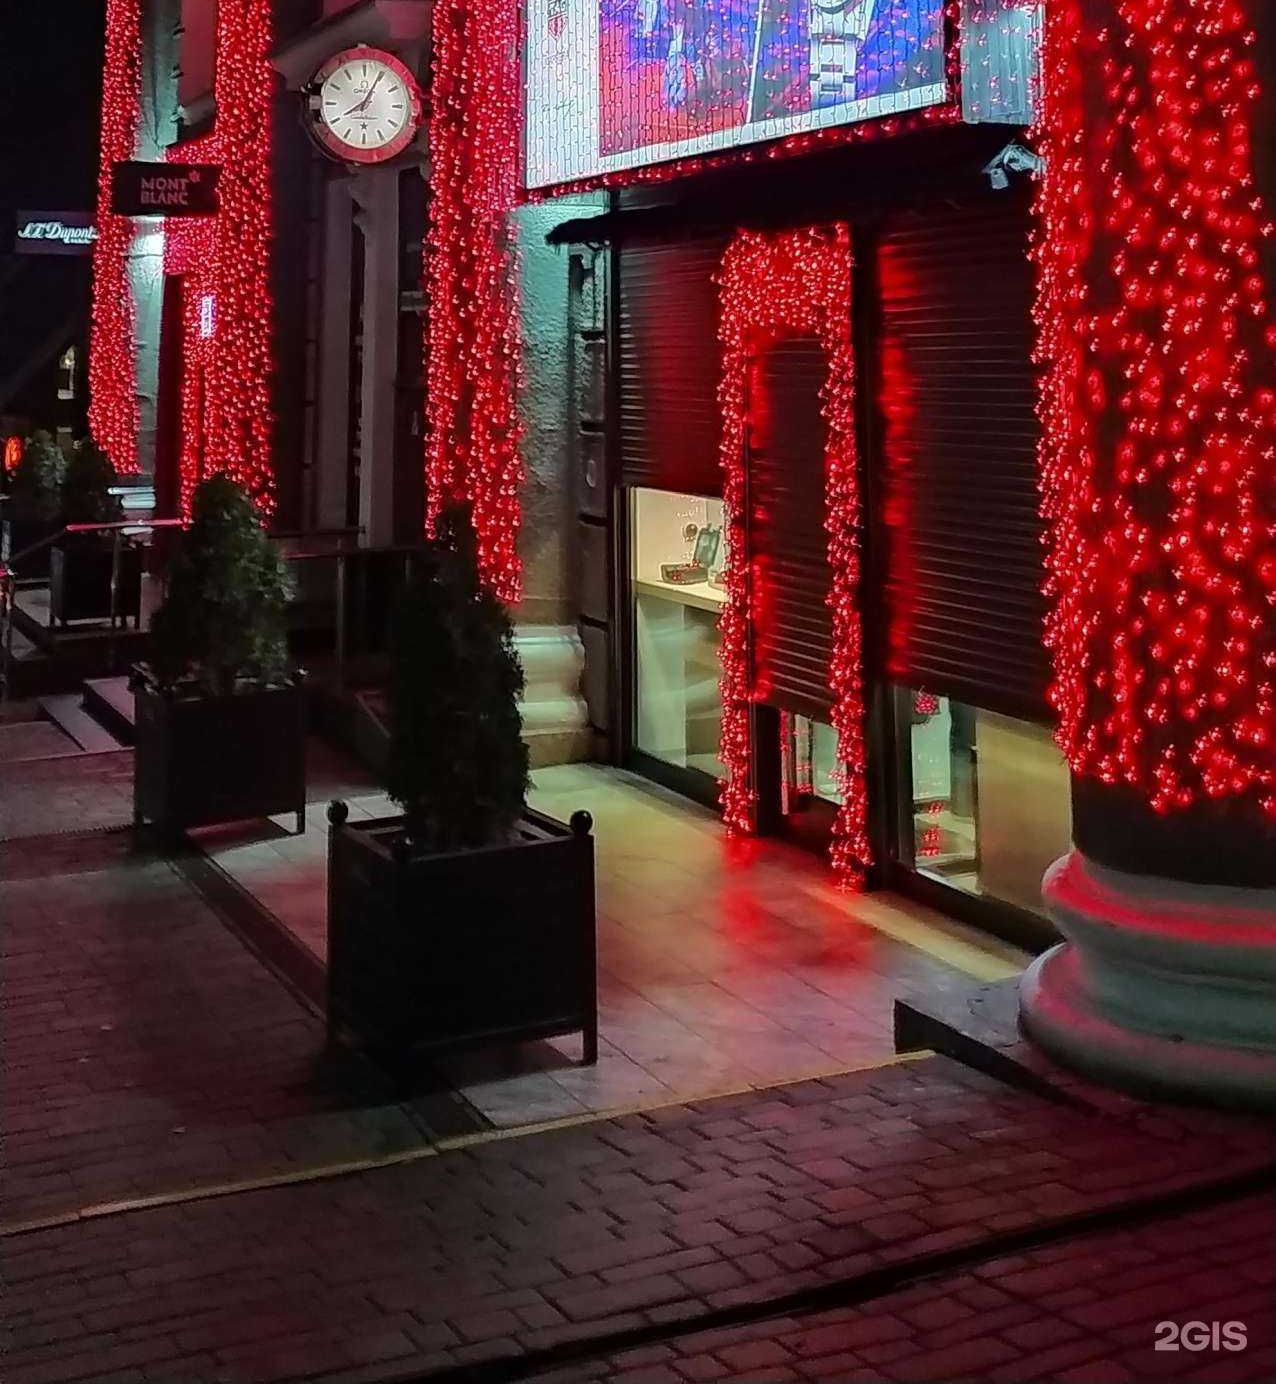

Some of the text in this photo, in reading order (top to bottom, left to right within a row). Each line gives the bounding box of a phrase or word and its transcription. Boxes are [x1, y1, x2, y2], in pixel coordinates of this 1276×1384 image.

[141, 176, 189, 191] MONT
[141, 191, 188, 206] BLANC
[45, 221, 99, 244] Dupont
